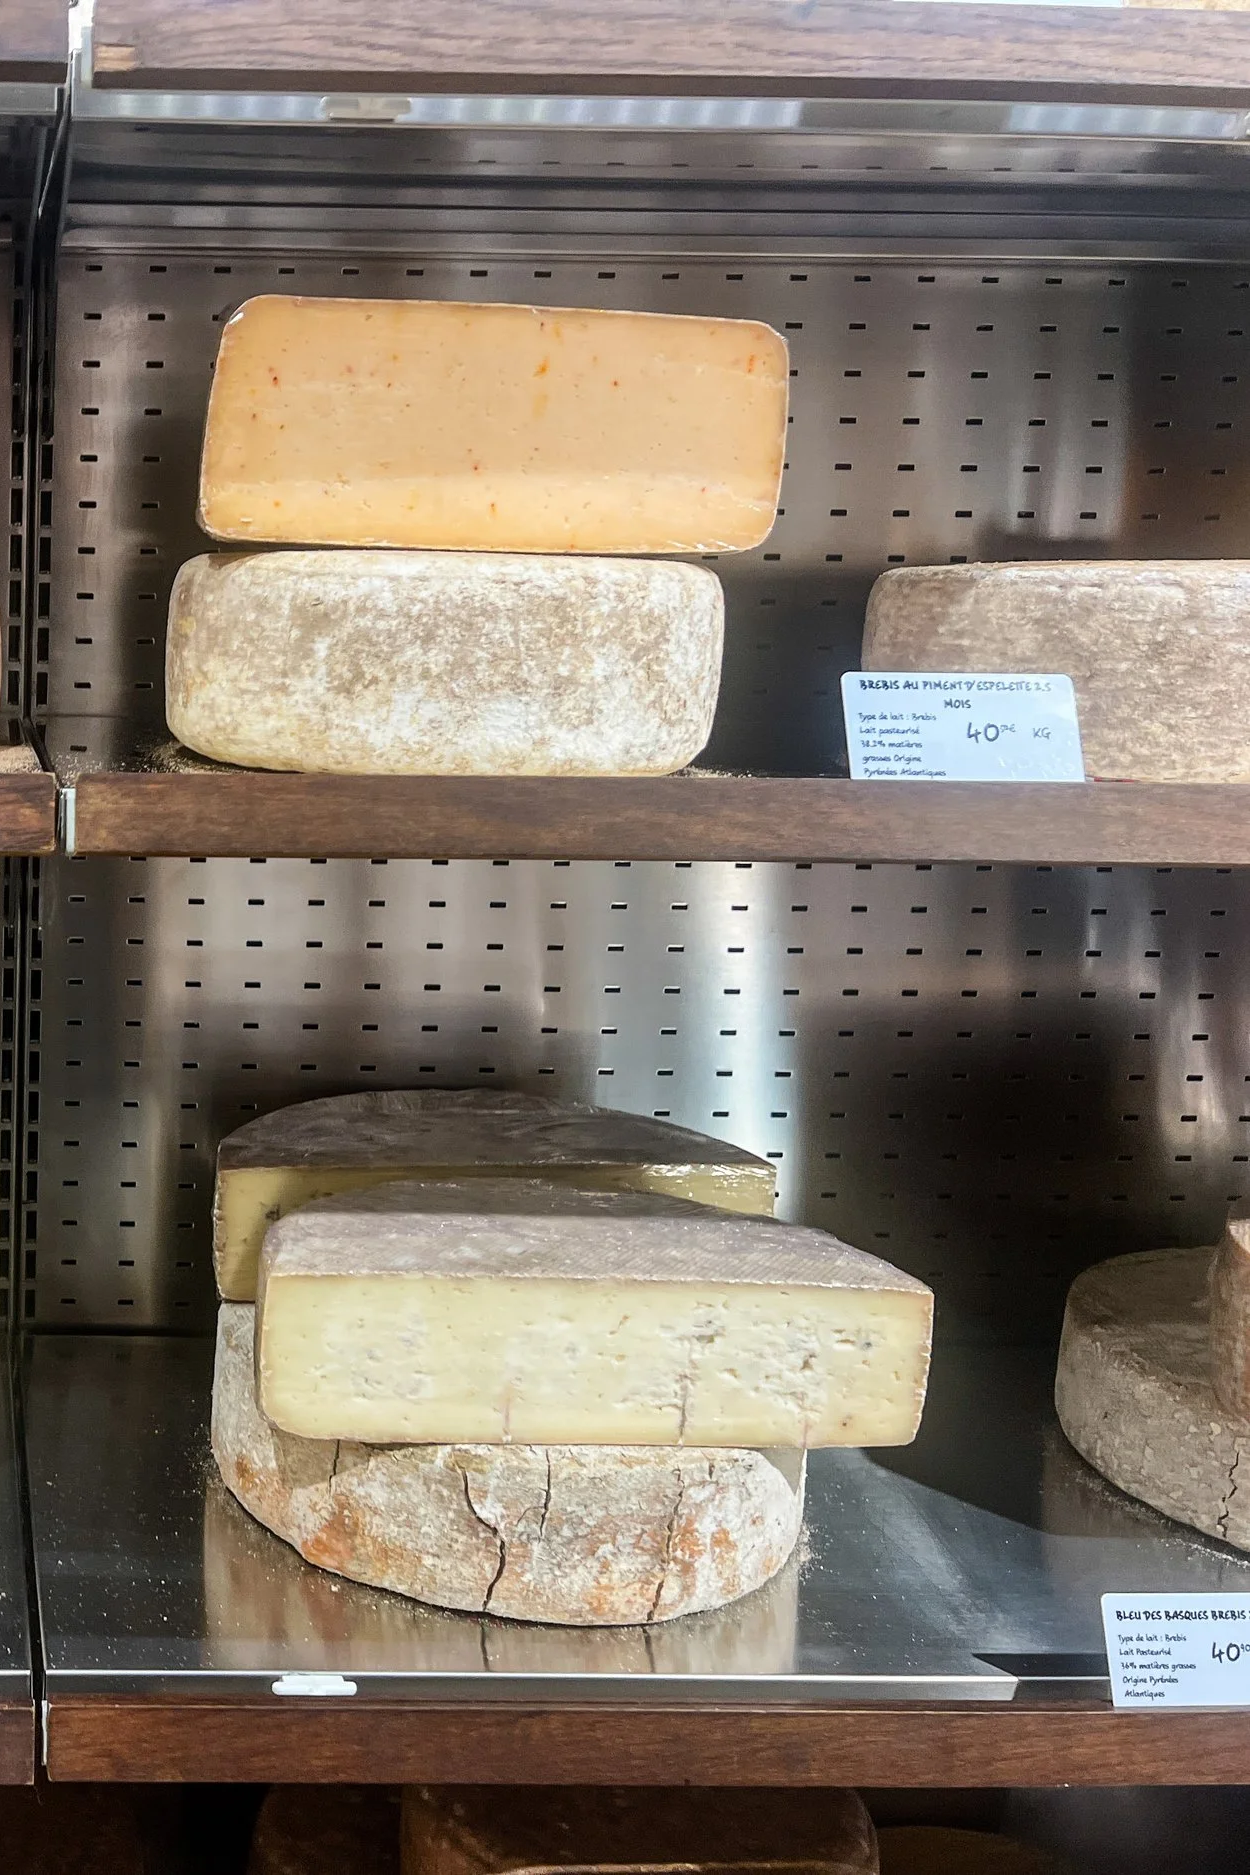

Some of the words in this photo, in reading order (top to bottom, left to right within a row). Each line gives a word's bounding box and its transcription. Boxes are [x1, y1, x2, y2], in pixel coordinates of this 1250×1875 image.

[859, 680, 899, 690] BREBIS
[903, 681, 918, 689] AU
[922, 680, 962, 690] PIMENT
[944, 699, 971, 709] MOIS
[858, 713, 876, 722] Type
[879, 712, 888, 720] de
[890, 712, 904, 720] lait
[912, 713, 936, 721] Brebis
[1033, 727, 1051, 740] KG
[862, 756, 891, 764] grasses
[894, 754, 921, 765] Origine
[900, 768, 946, 778] Atlantiques
[1116, 1611, 1141, 1621] BLEU
[1143, 1611, 1162, 1620] DES
[1164, 1611, 1208, 1621] BASQUES
[1211, 1610, 1246, 1621] BREBIS
[1118, 1635, 1133, 1645] Type
[1136, 1633, 1144, 1641] de
[1165, 1634, 1186, 1642] Brebis
[1172, 1664, 1196, 1672] grasses
[1123, 1676, 1147, 1686] Origine
[1125, 1689, 1165, 1701] Atlantiques
